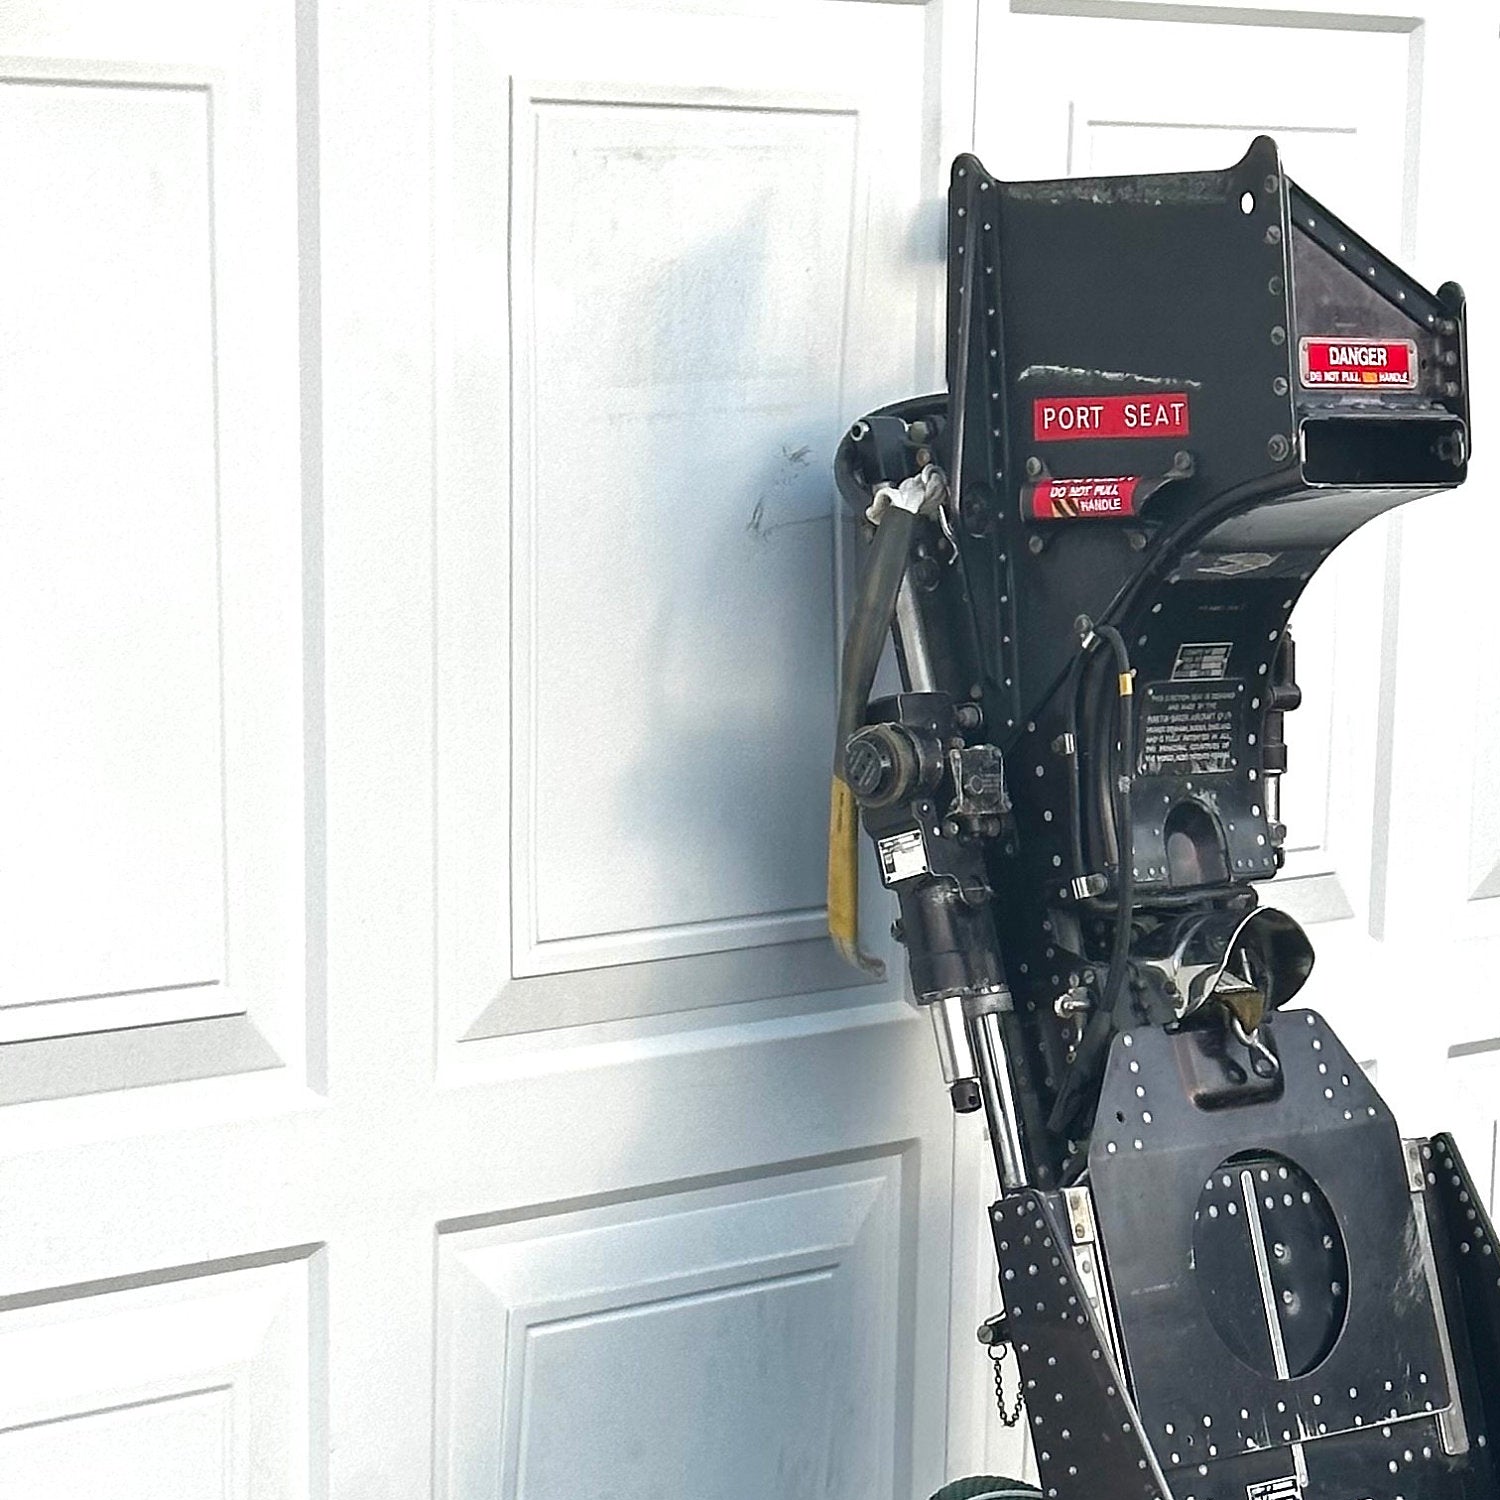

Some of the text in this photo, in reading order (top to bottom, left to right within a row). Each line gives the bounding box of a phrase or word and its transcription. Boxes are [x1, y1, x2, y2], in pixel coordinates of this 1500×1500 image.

[1329, 347, 1387, 366] DANGER
[1310, 371, 1408, 383] DO NOT PULL HANDLE
[1043, 403, 1185, 429] PORT SEAT
[1050, 485, 1119, 498] DO NOT PULL
[1080, 498, 1121, 511] HANDLE
